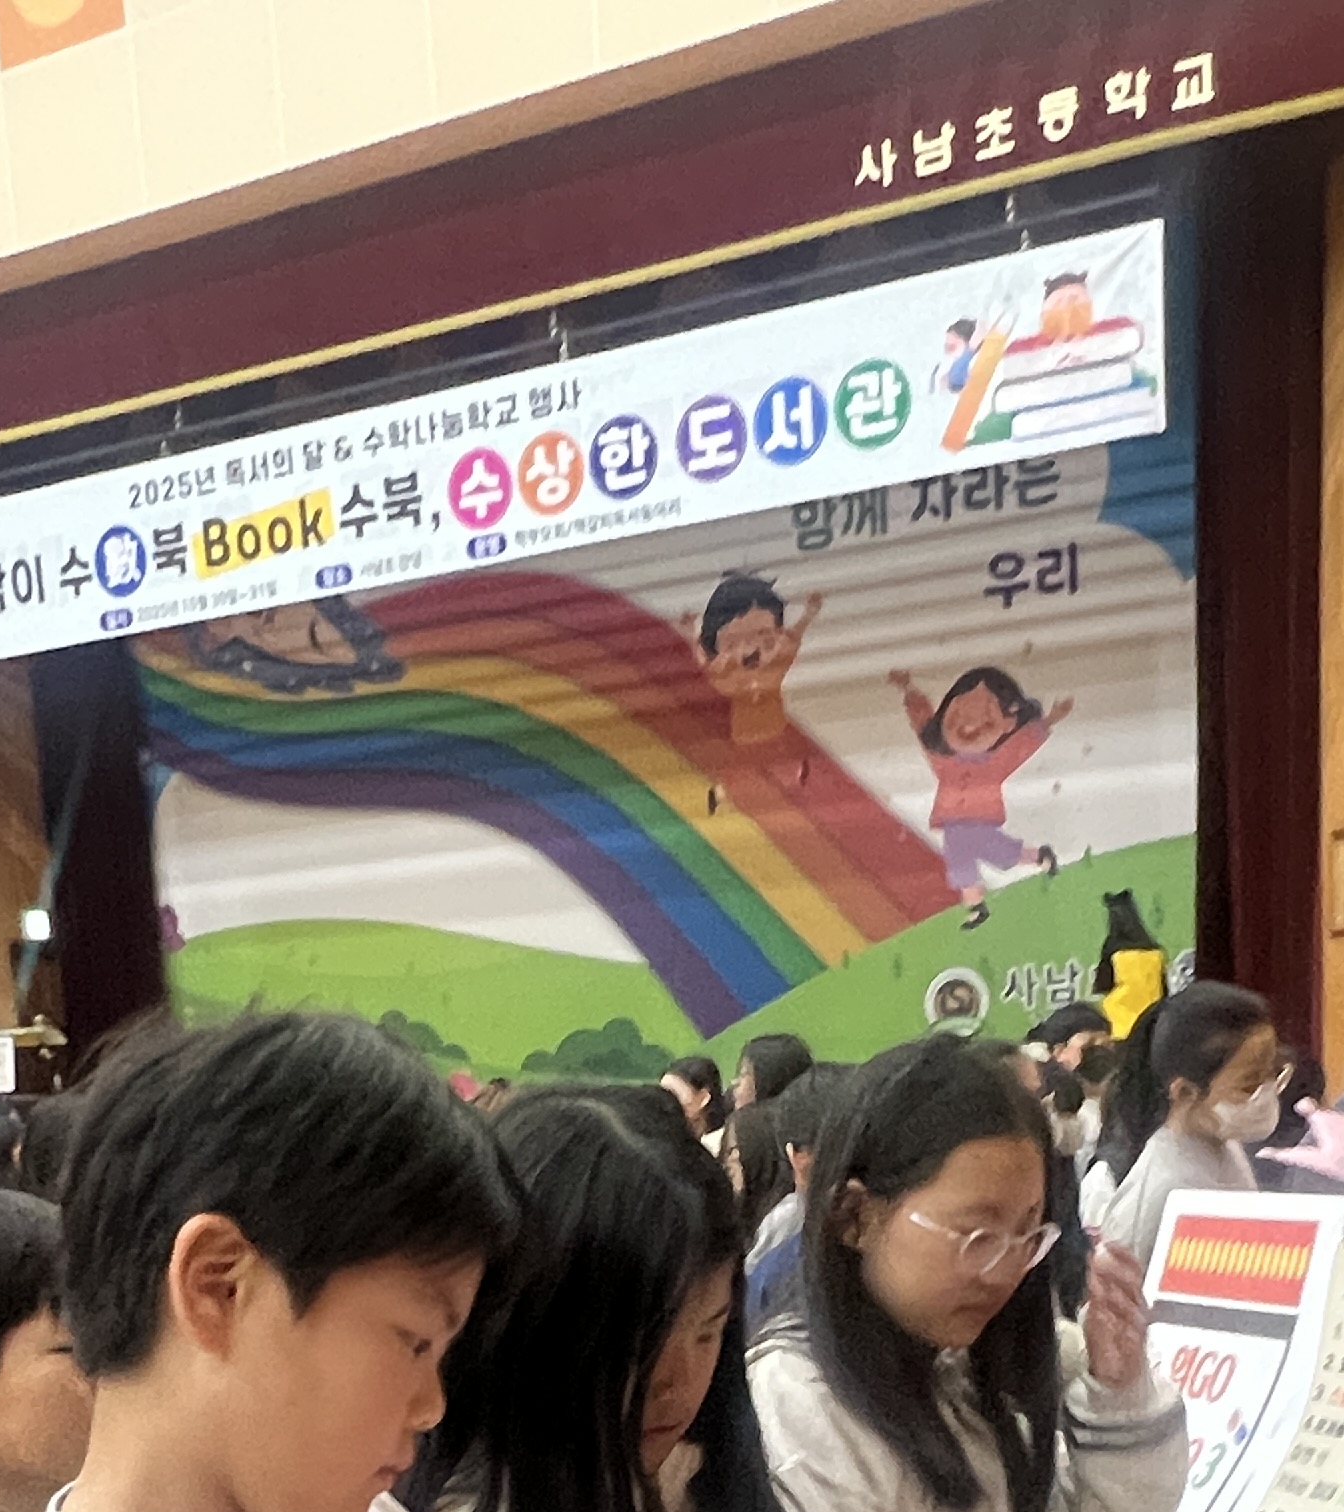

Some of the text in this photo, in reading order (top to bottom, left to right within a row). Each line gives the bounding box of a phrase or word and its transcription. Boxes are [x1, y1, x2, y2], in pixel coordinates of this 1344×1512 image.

[128, 467, 218, 511] 2025년
[302, 439, 328, 472] 달
[333, 435, 353, 460] &
[528, 377, 584, 420] 행사
[202, 495, 326, 567] Book
[453, 418, 654, 524] 수상한
[683, 362, 906, 477] 도서관
[910, 460, 1061, 521] 자라는
[984, 542, 1080, 609] 우리
